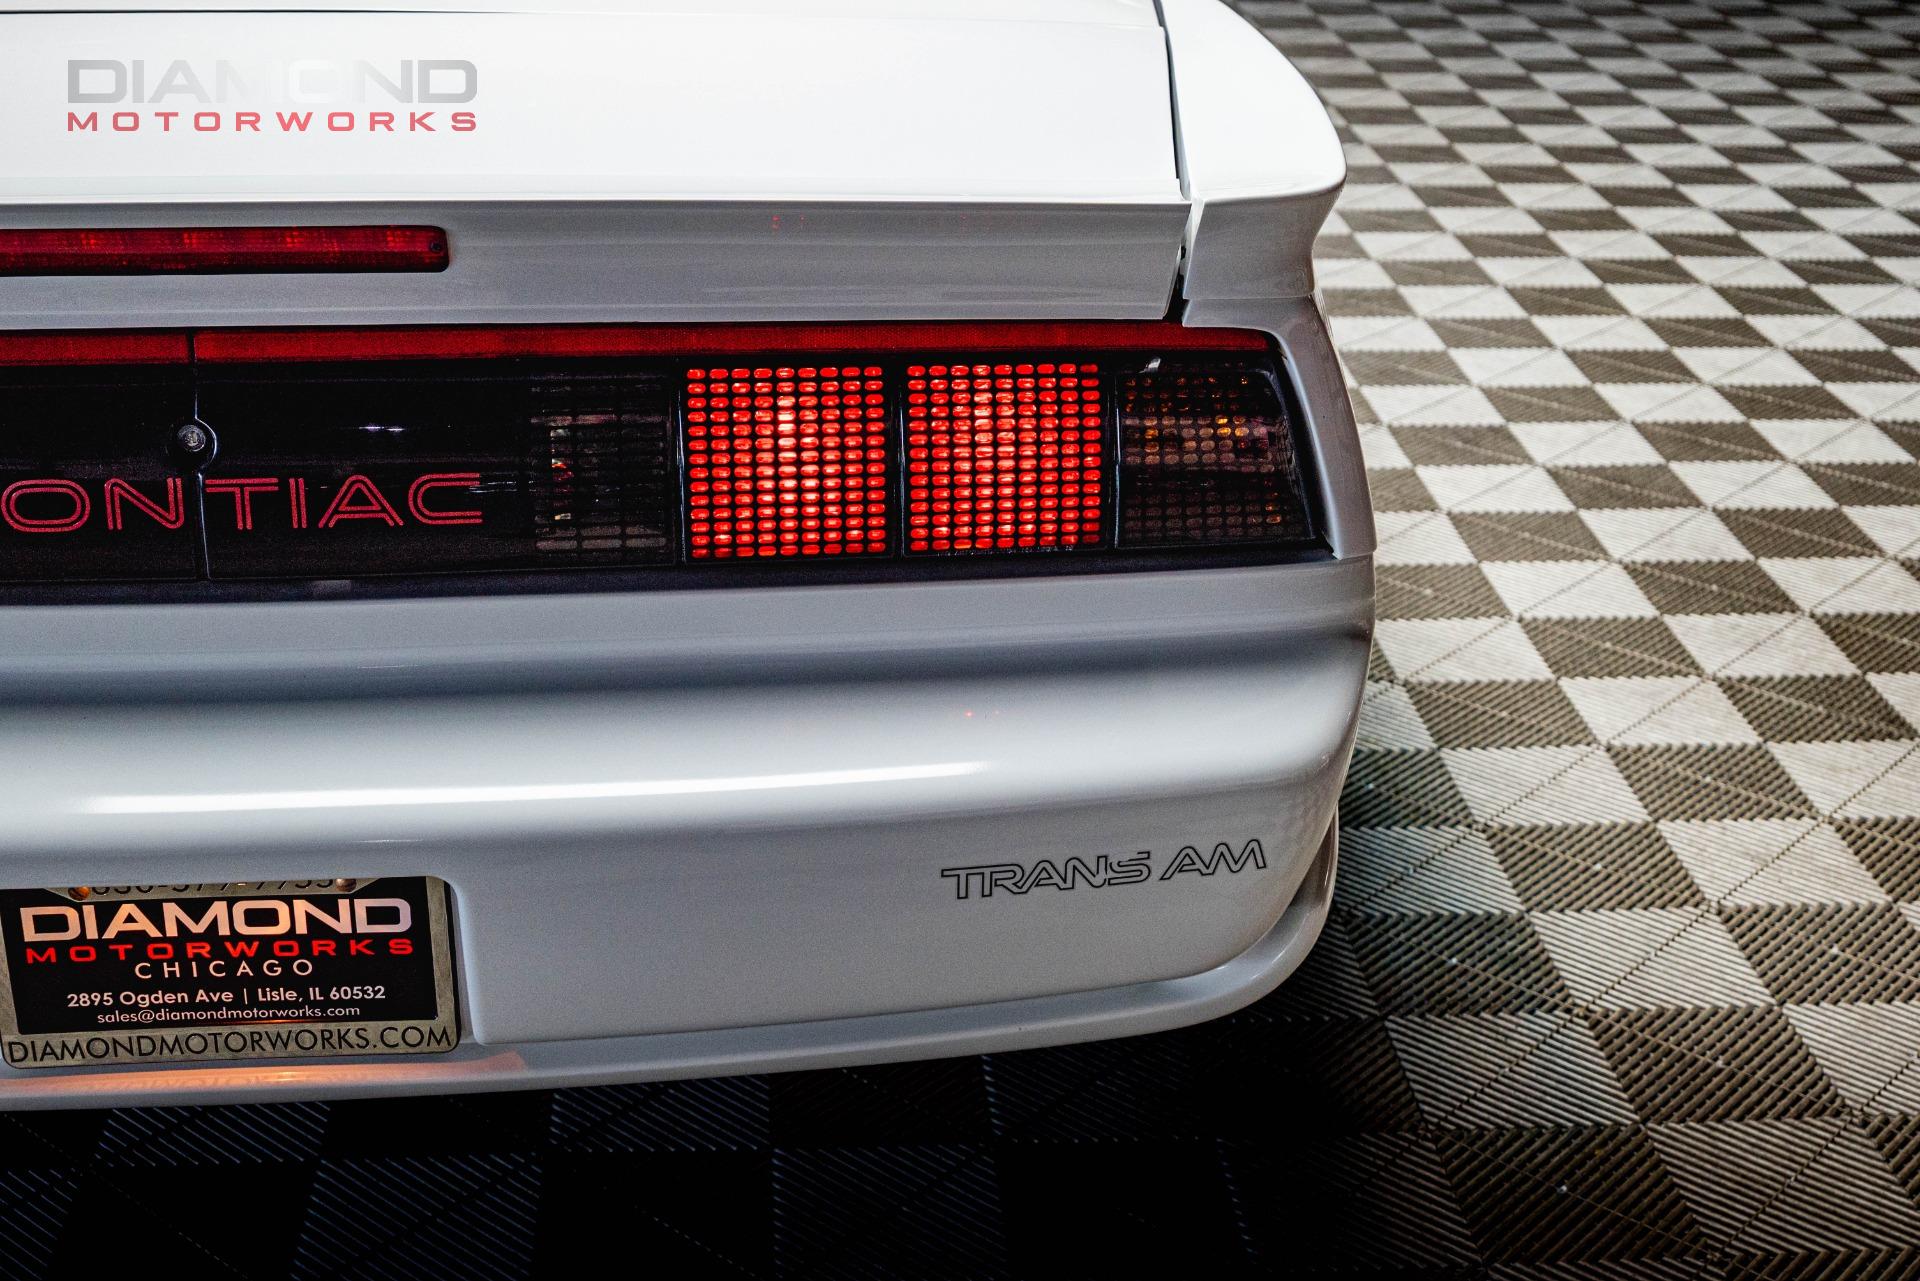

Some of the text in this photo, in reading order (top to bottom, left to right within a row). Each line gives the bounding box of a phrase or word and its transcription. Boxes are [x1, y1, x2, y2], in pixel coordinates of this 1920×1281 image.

[941, 839, 1266, 900] TRANS AM
[20, 898, 412, 942] DIAMOND
[25, 939, 414, 964] MOTORWORKS
[134, 959, 313, 979] CHICAGO
[67, 992, 114, 1007] 2895
[119, 990, 189, 1008] Ogden
[195, 988, 234, 1003] Ave
[258, 987, 303, 1002] Lisle,
[308, 987, 324, 1000] IL
[329, 985, 386, 1000] 60532
[97, 1005, 361, 1023] sales@diamondmotorworks.com
[8, 1026, 451, 1063] DIAMONDMOTORWORKS.COM
